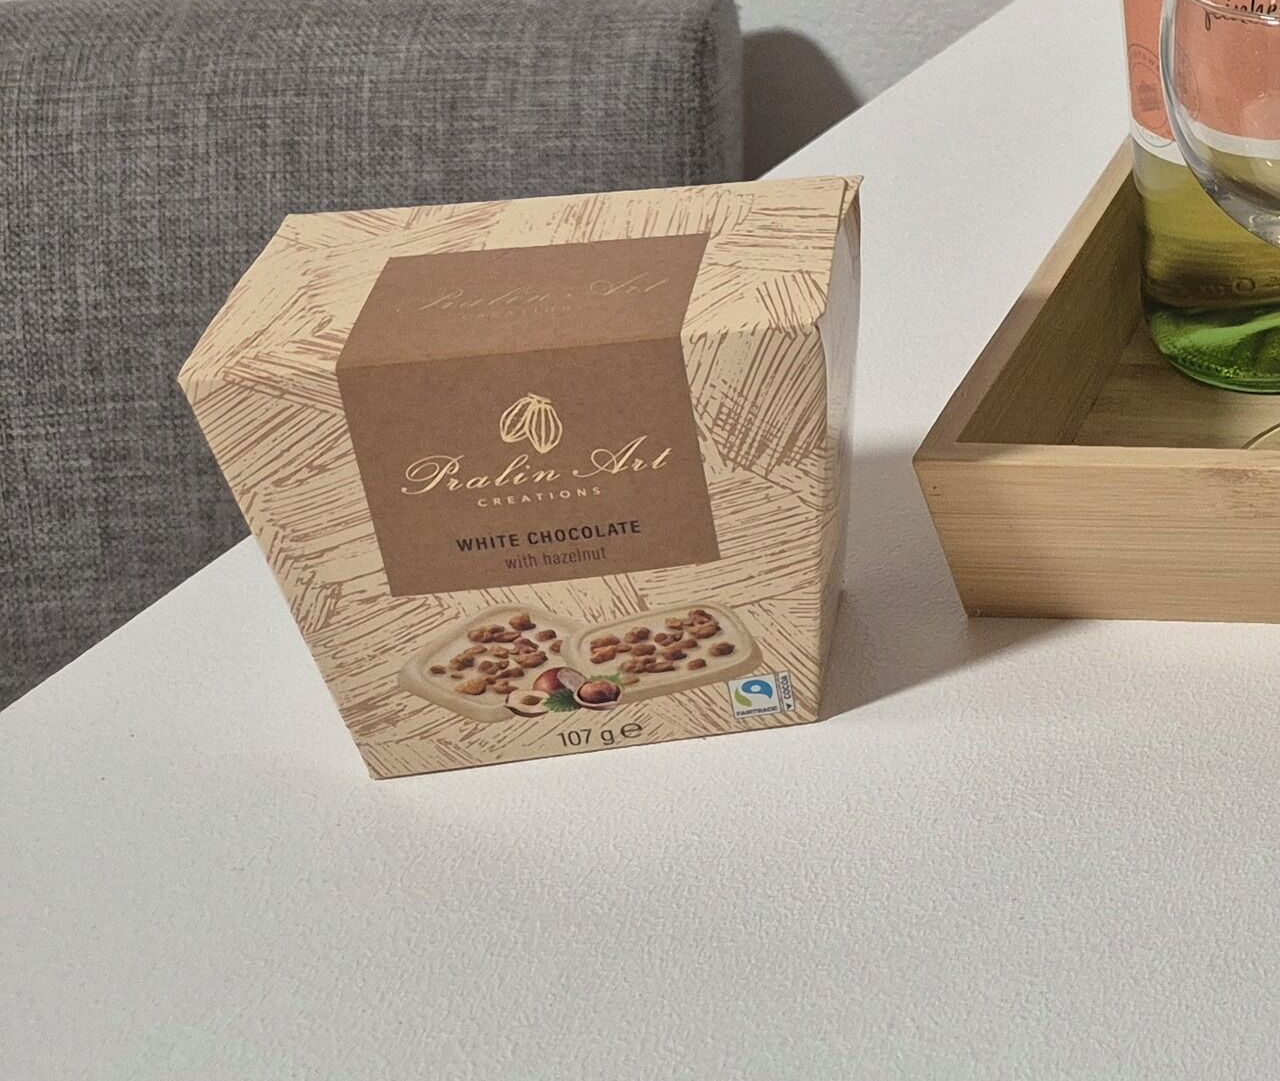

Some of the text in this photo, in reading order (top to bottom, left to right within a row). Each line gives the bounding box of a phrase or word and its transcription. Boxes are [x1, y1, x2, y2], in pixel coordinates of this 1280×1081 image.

[401, 435, 672, 495] Pralin Art
[478, 486, 601, 507] CREATIONS
[456, 520, 642, 553] WHITE CHOCOLATE
[505, 546, 607, 570] with hazelnut
[556, 727, 592, 748] 107
[600, 728, 616, 748] g
